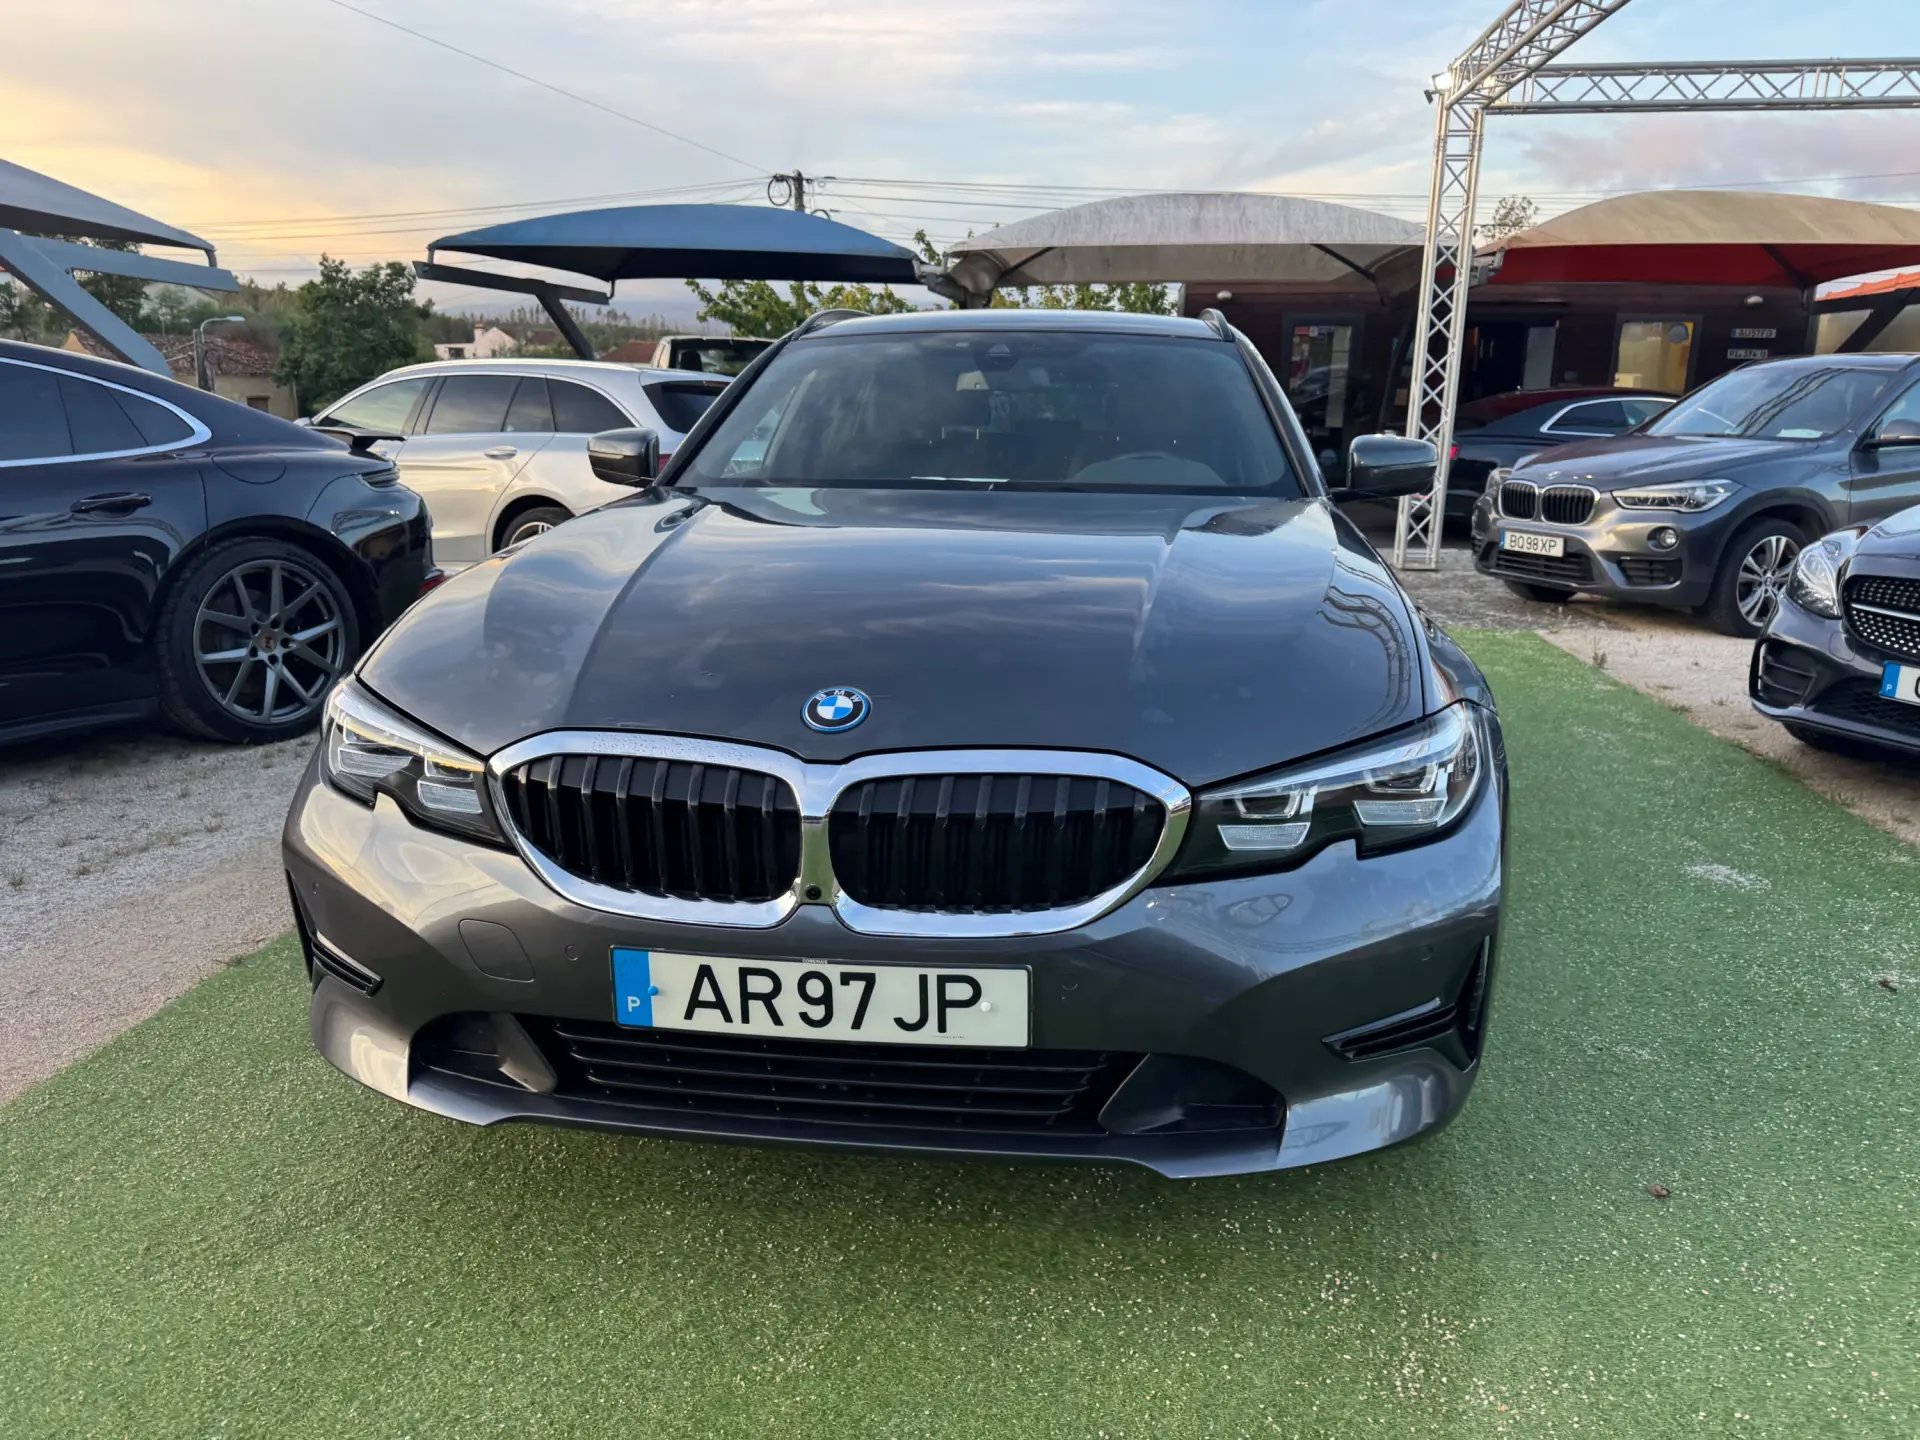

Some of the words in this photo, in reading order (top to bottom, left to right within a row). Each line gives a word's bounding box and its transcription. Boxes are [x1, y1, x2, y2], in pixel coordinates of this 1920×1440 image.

[1526, 537, 1539, 551] 98
[1540, 538, 1556, 552] XP
[815, 689, 863, 703] BMW
[627, 996, 641, 1013] P
[683, 963, 784, 1027] AR
[796, 970, 877, 1031] 97
[893, 973, 983, 1034] JP
